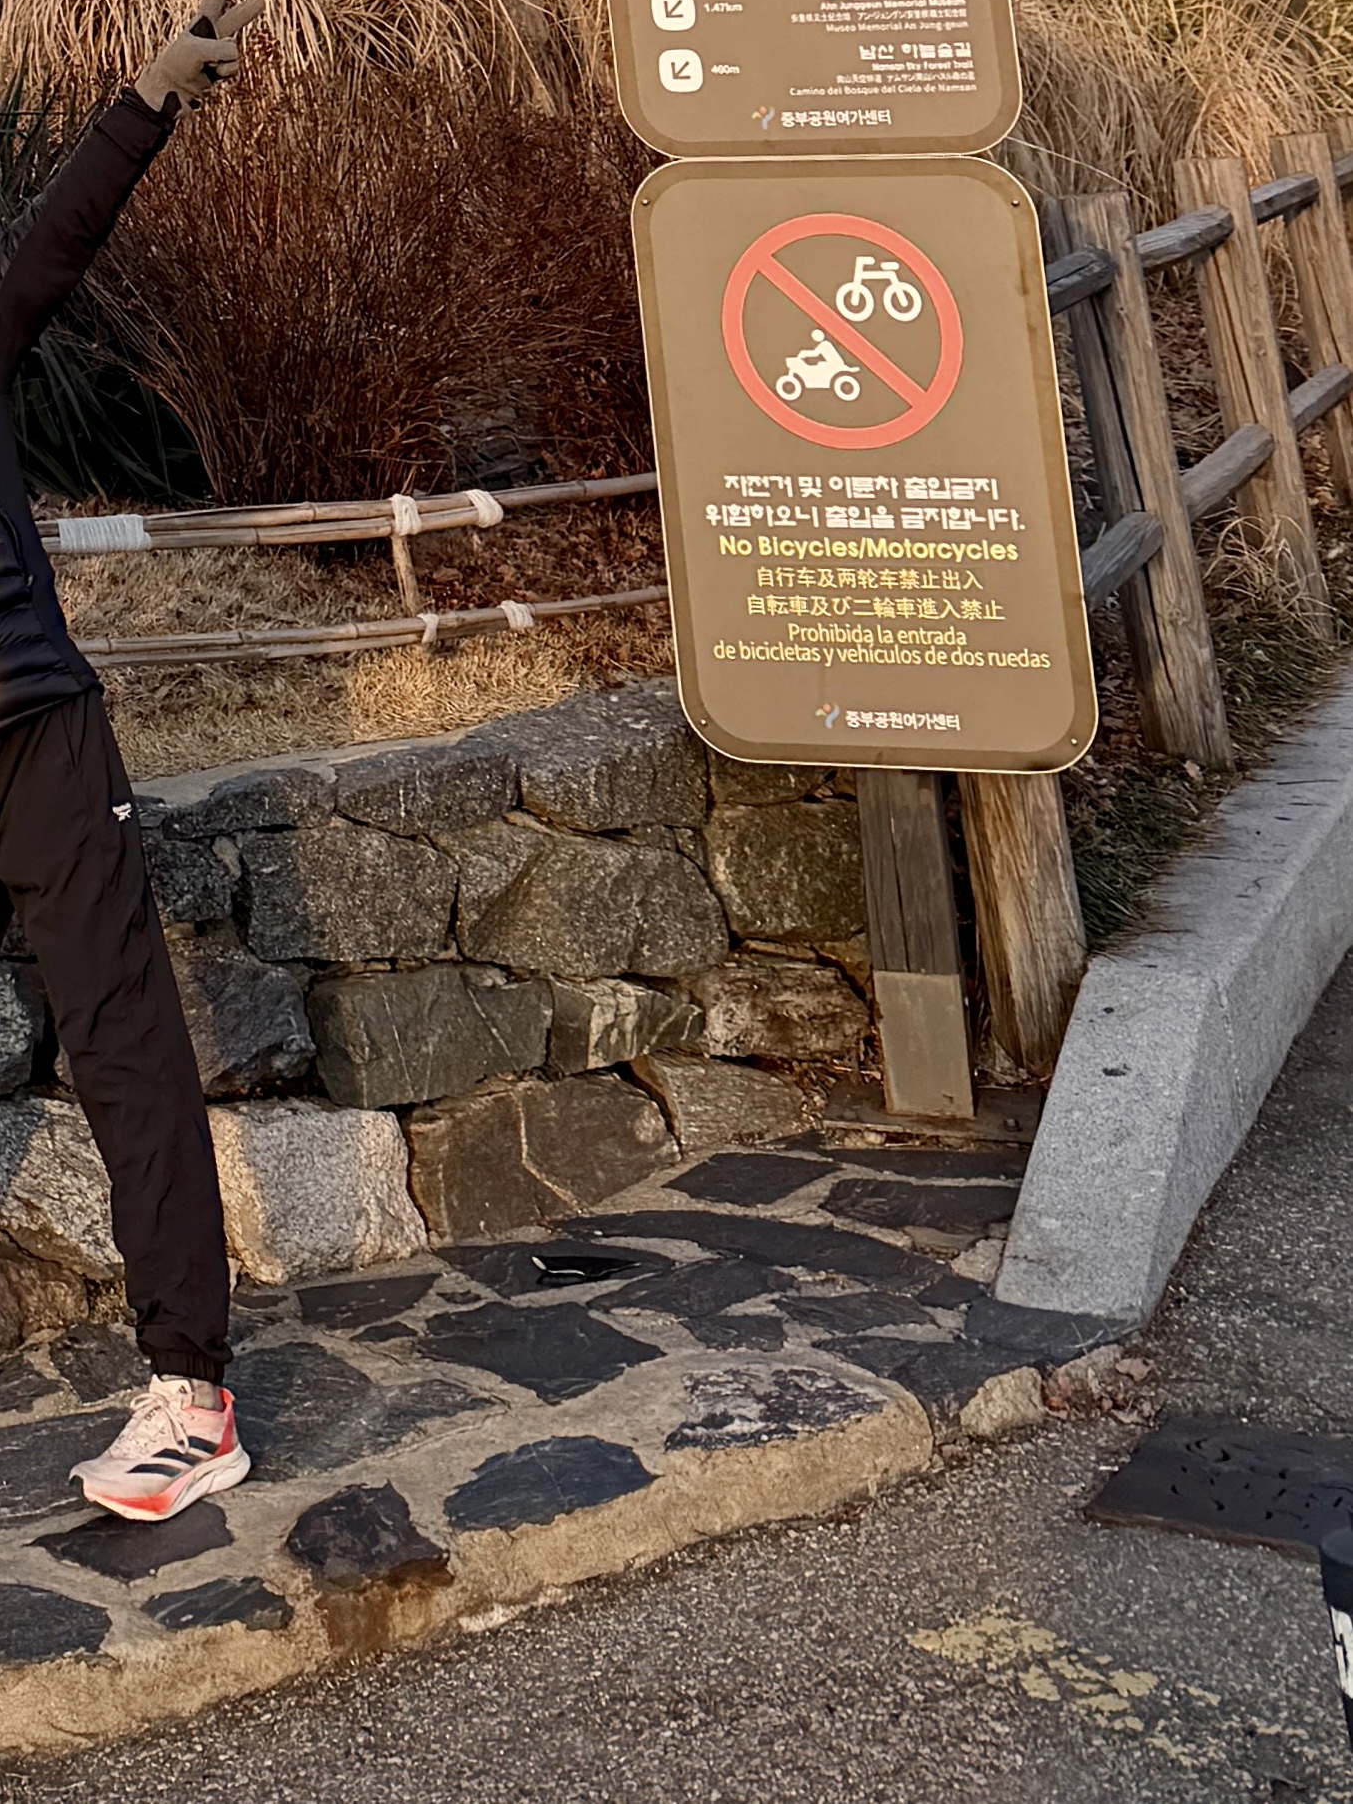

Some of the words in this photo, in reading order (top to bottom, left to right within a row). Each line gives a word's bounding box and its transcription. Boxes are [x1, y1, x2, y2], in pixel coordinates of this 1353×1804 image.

[859, 45, 895, 60] 남산
[923, 83, 936, 93] de
[780, 108, 893, 128] 중부공원여가센터
[723, 474, 794, 498] 자전거
[798, 476, 823, 498] 및
[828, 475, 899, 500] 이륜차
[903, 476, 999, 501] 출입금지
[705, 503, 820, 528] 위험하오니
[825, 505, 895, 529] 출입을
[900, 506, 1026, 532] 금지합니다.
[719, 534, 753, 556] No
[757, 535, 1019, 563] Bicycles/Motorcycles
[756, 566, 984, 591] 自行车及两轮车禁止出入
[787, 622, 874, 644] Prohibida
[877, 624, 894, 644] la
[897, 625, 968, 645] entrada
[713, 639, 736, 660] de
[738, 640, 822, 662] bicicletas
[823, 646, 835, 667] y
[837, 642, 922, 665] vehículos
[924, 645, 948, 666] de
[950, 646, 985, 667] dos
[987, 648, 1052, 669] ruedas
[845, 710, 962, 732] 중부공원여가센터
